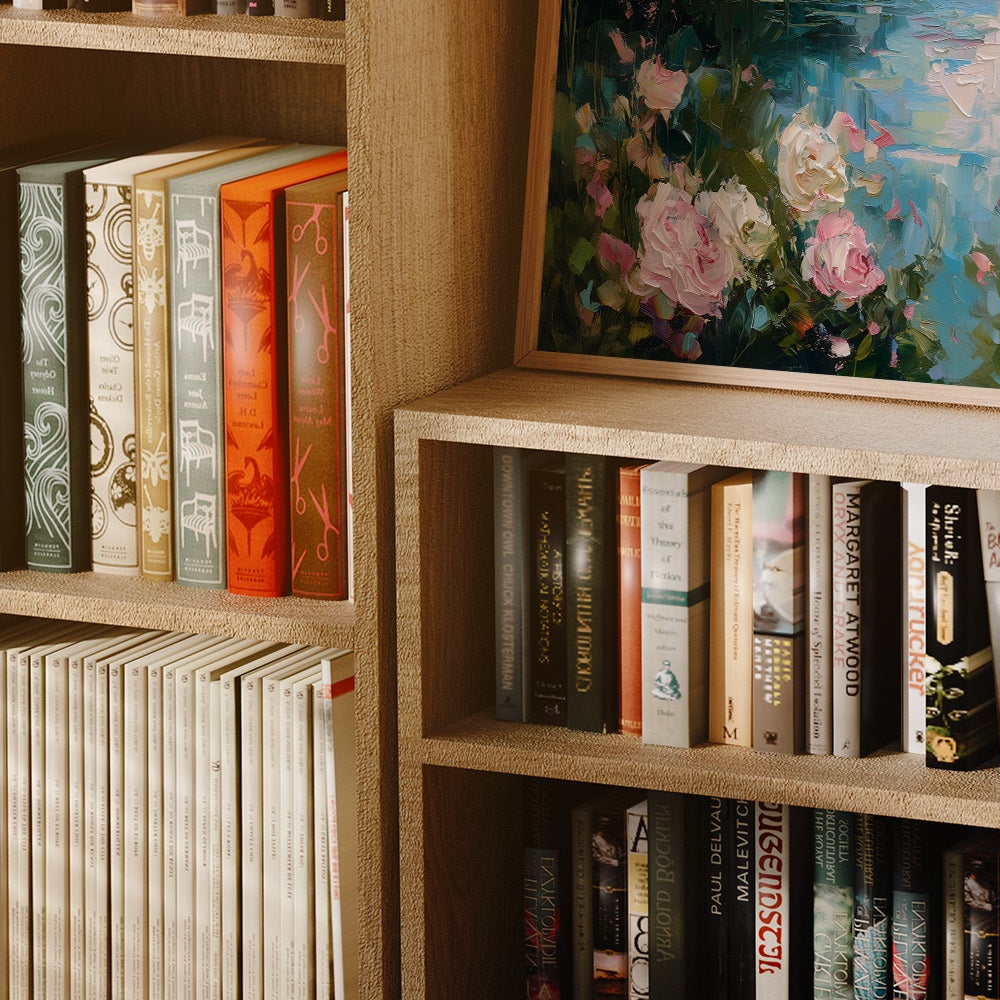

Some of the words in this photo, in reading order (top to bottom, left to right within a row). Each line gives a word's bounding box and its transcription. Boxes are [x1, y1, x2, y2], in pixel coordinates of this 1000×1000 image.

[501, 454, 514, 530] DOWNTOWN
[660, 504, 671, 514] of
[834, 492, 846, 545] ORYX
[501, 531, 514, 558] OWL
[650, 537, 682, 550] Theory
[661, 555, 671, 564] of
[845, 493, 860, 606] MARGARET
[501, 563, 515, 606] CHUCK
[834, 550, 845, 593] AND
[501, 608, 515, 690] KLOSTERMAN
[834, 601, 845, 669] CRAKE
[845, 611, 860, 697] ATWOOD
[722, 726, 737, 741] M
[710, 872, 722, 916] PAUL
